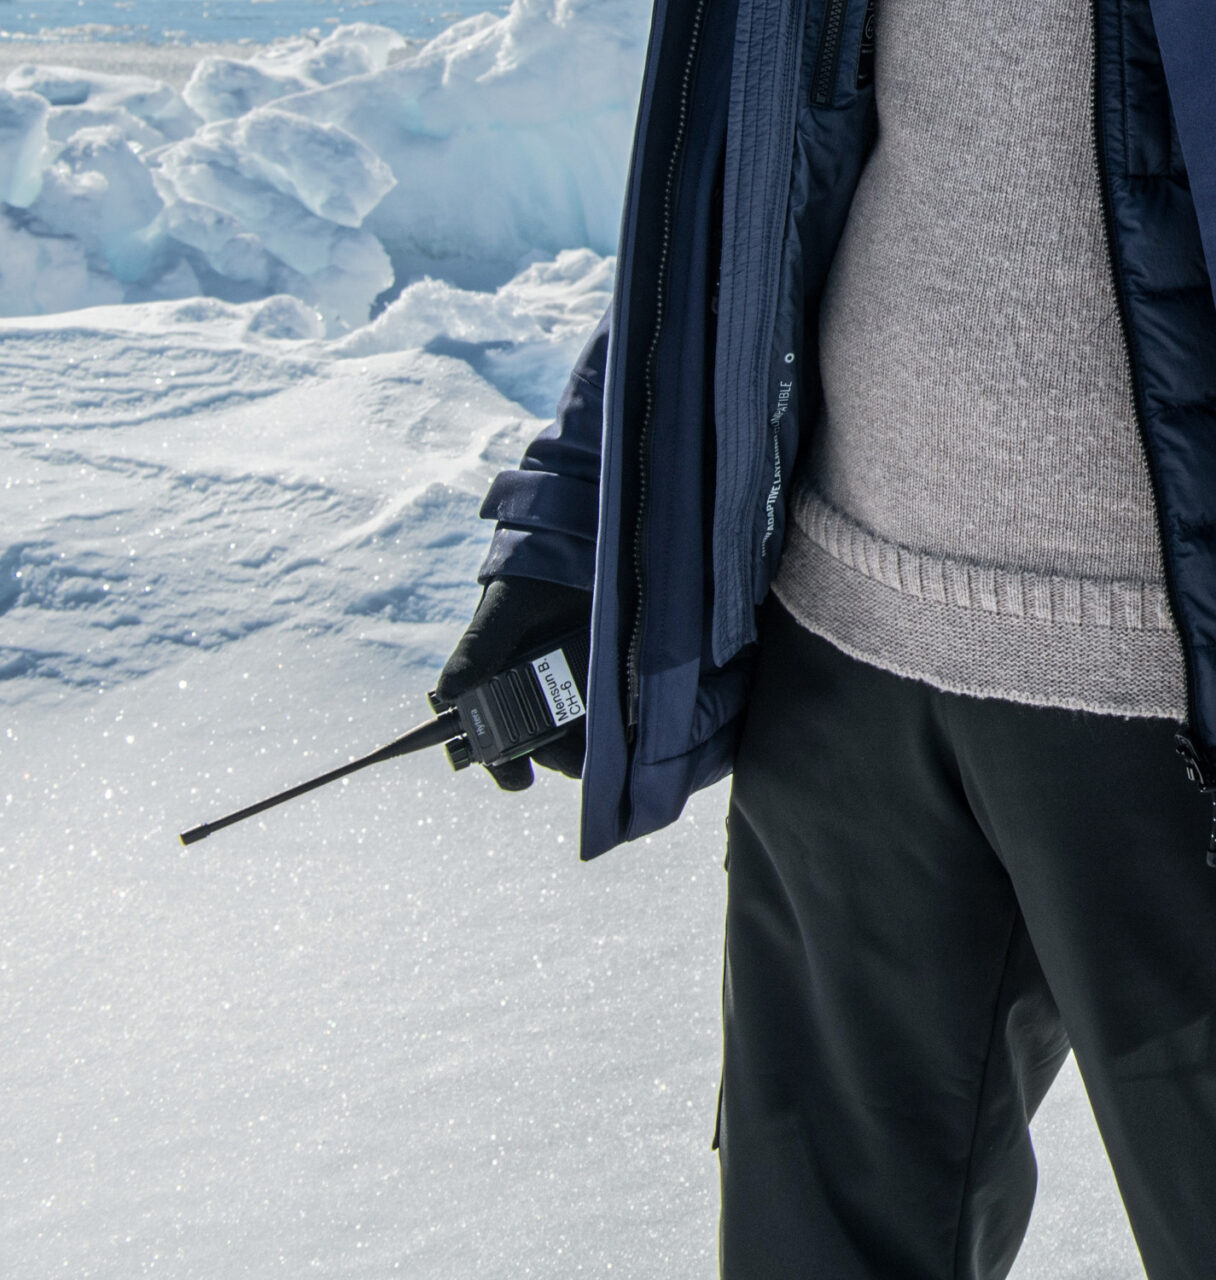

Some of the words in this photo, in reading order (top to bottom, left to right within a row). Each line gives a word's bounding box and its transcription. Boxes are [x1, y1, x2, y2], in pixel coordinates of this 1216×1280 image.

[766, 481, 781, 532] ADAPTIVE
[538, 658, 550, 673] B.
[545, 673, 569, 722] Mensun
[560, 679, 581, 716] CH-6
